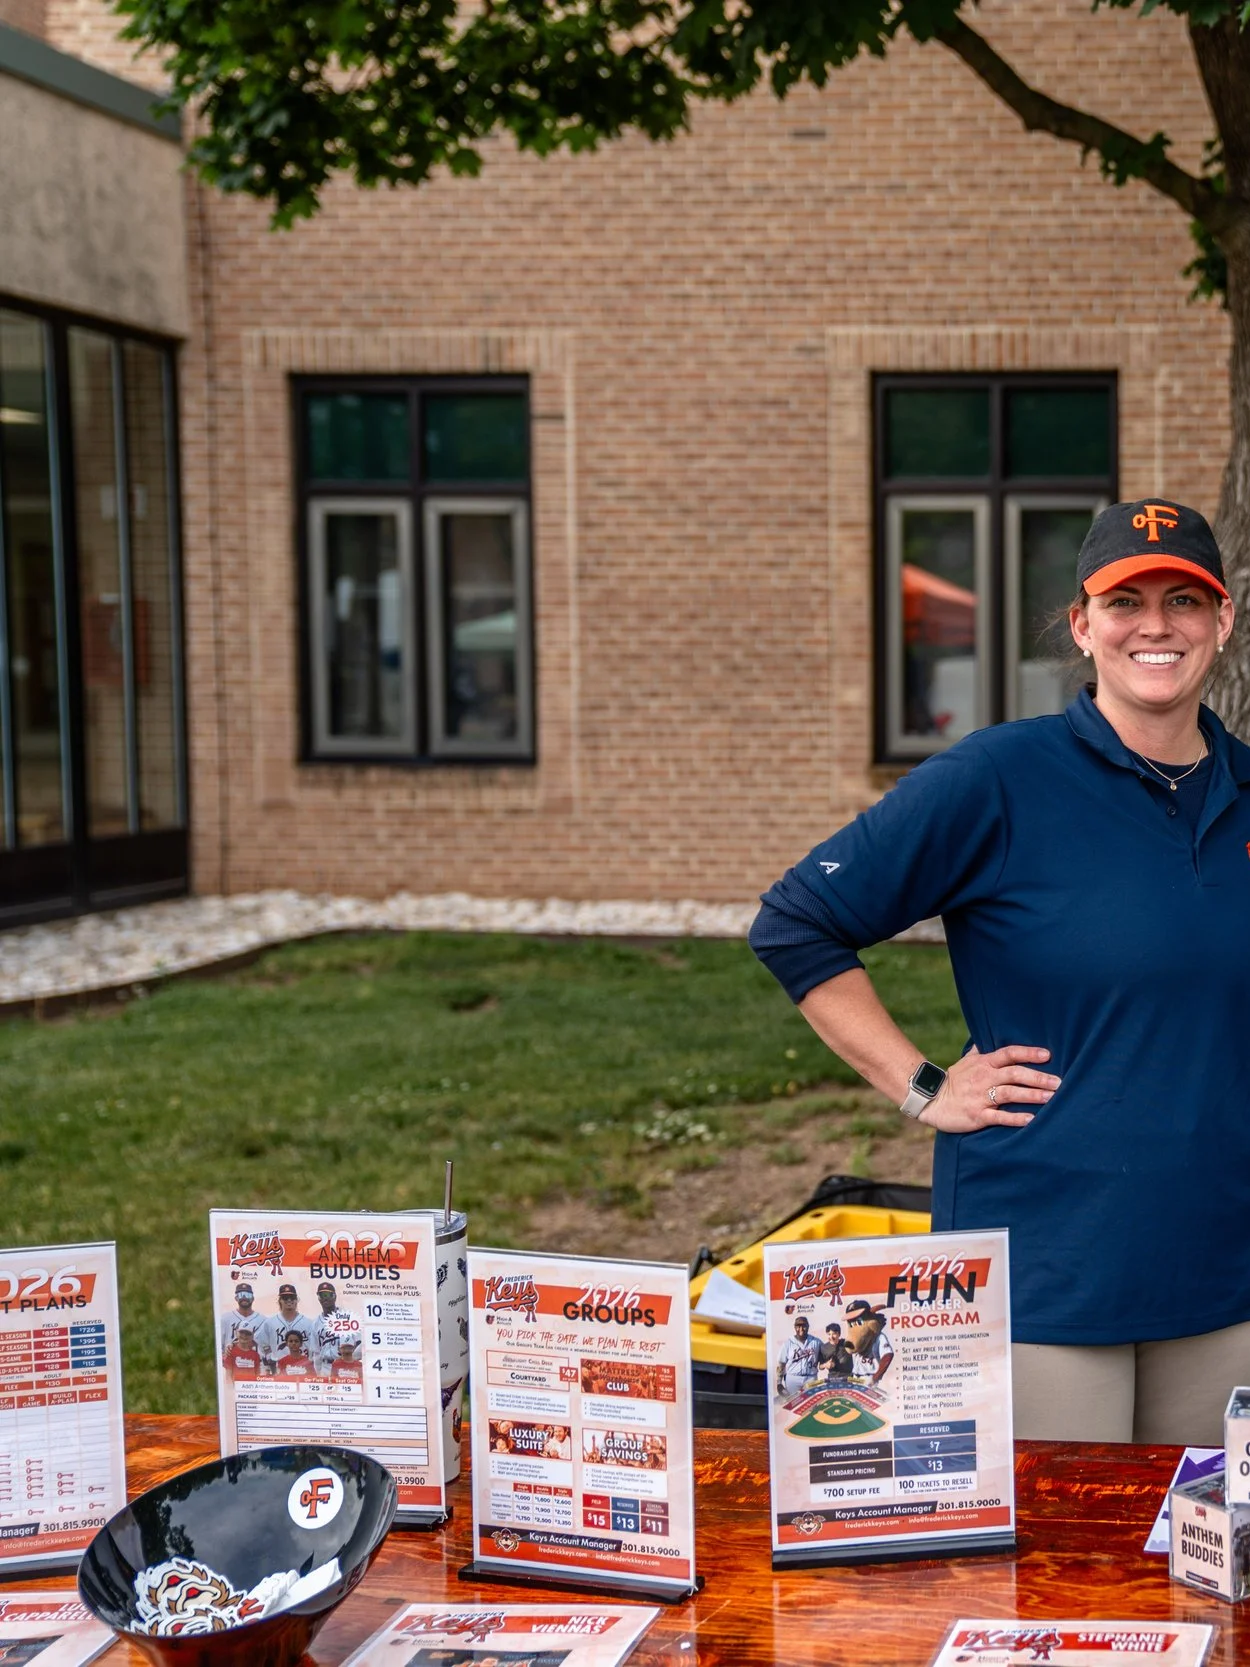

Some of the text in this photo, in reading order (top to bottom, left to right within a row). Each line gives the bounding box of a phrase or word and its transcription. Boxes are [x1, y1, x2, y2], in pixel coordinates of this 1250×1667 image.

[249, 1230, 279, 1240] FREDERICK
[230, 1233, 284, 1266] Keys
[303, 1229, 406, 1262] 2026
[318, 1248, 391, 1263] ANTHEM
[806, 1258, 839, 1271] FREDERICK
[898, 1251, 966, 1280] 2026
[310, 1263, 401, 1281] BUDDIES
[504, 1274, 533, 1283] FREDERICK
[783, 1264, 844, 1298] Keys
[485, 1276, 538, 1310] Keys
[574, 1281, 641, 1310] 2026
[886, 1271, 977, 1308] FUN
[20, 1294, 87, 1313] PLANS
[900, 1299, 962, 1313] DRAISER
[366, 1304, 383, 1317] 10
[563, 1302, 656, 1328] GROUPS
[328, 1320, 360, 1332] $250
[890, 1311, 980, 1330] PROGRAM
[371, 1332, 381, 1345] 5
[912, 1353, 929, 1362] KEEP
[372, 1360, 383, 1371] 4
[562, 1369, 576, 1379] $47
[375, 1386, 381, 1398] 1
[606, 1381, 630, 1392] CLUB
[509, 1428, 549, 1440] LUXURY
[919, 1425, 950, 1434] RESERVED
[516, 1439, 543, 1451] SUITE
[605, 1438, 643, 1450] GROUP
[929, 1441, 940, 1452] $7
[601, 1448, 648, 1462] SAVINGS
[822, 1447, 879, 1459] FUNDRAISING PRICING
[827, 1466, 876, 1477] STANDARD PRICING
[927, 1460, 943, 1472] $13
[898, 1477, 973, 1489] 100 TICKETS TO RESELL
[823, 1486, 881, 1498] $700 SETUP FEE
[835, 1498, 1001, 1520] Keys Account Manager 301.815.9000
[43, 1518, 106, 1532] 301.815.9900
[588, 1513, 606, 1526] $15
[616, 1515, 635, 1530] $13
[646, 1519, 663, 1533] $11
[844, 1512, 979, 1529] frederickkeys.com info@frederickkeys.com
[1181, 1522, 1224, 1549] ANTHEM
[3, 1535, 87, 1550] info@frederickkeys.com
[529, 1532, 680, 1557] Keys Account Manager 301.815.9000
[538, 1546, 661, 1567] frederickkeys.com info@frederickkeys.com
[1181, 1539, 1224, 1569] BUDDIES
[568, 1616, 608, 1625] NICK
[530, 1625, 603, 1634] VIENNAS
[1076, 1632, 1167, 1644] STEPHANIE
[1110, 1641, 1164, 1652] WHITE
